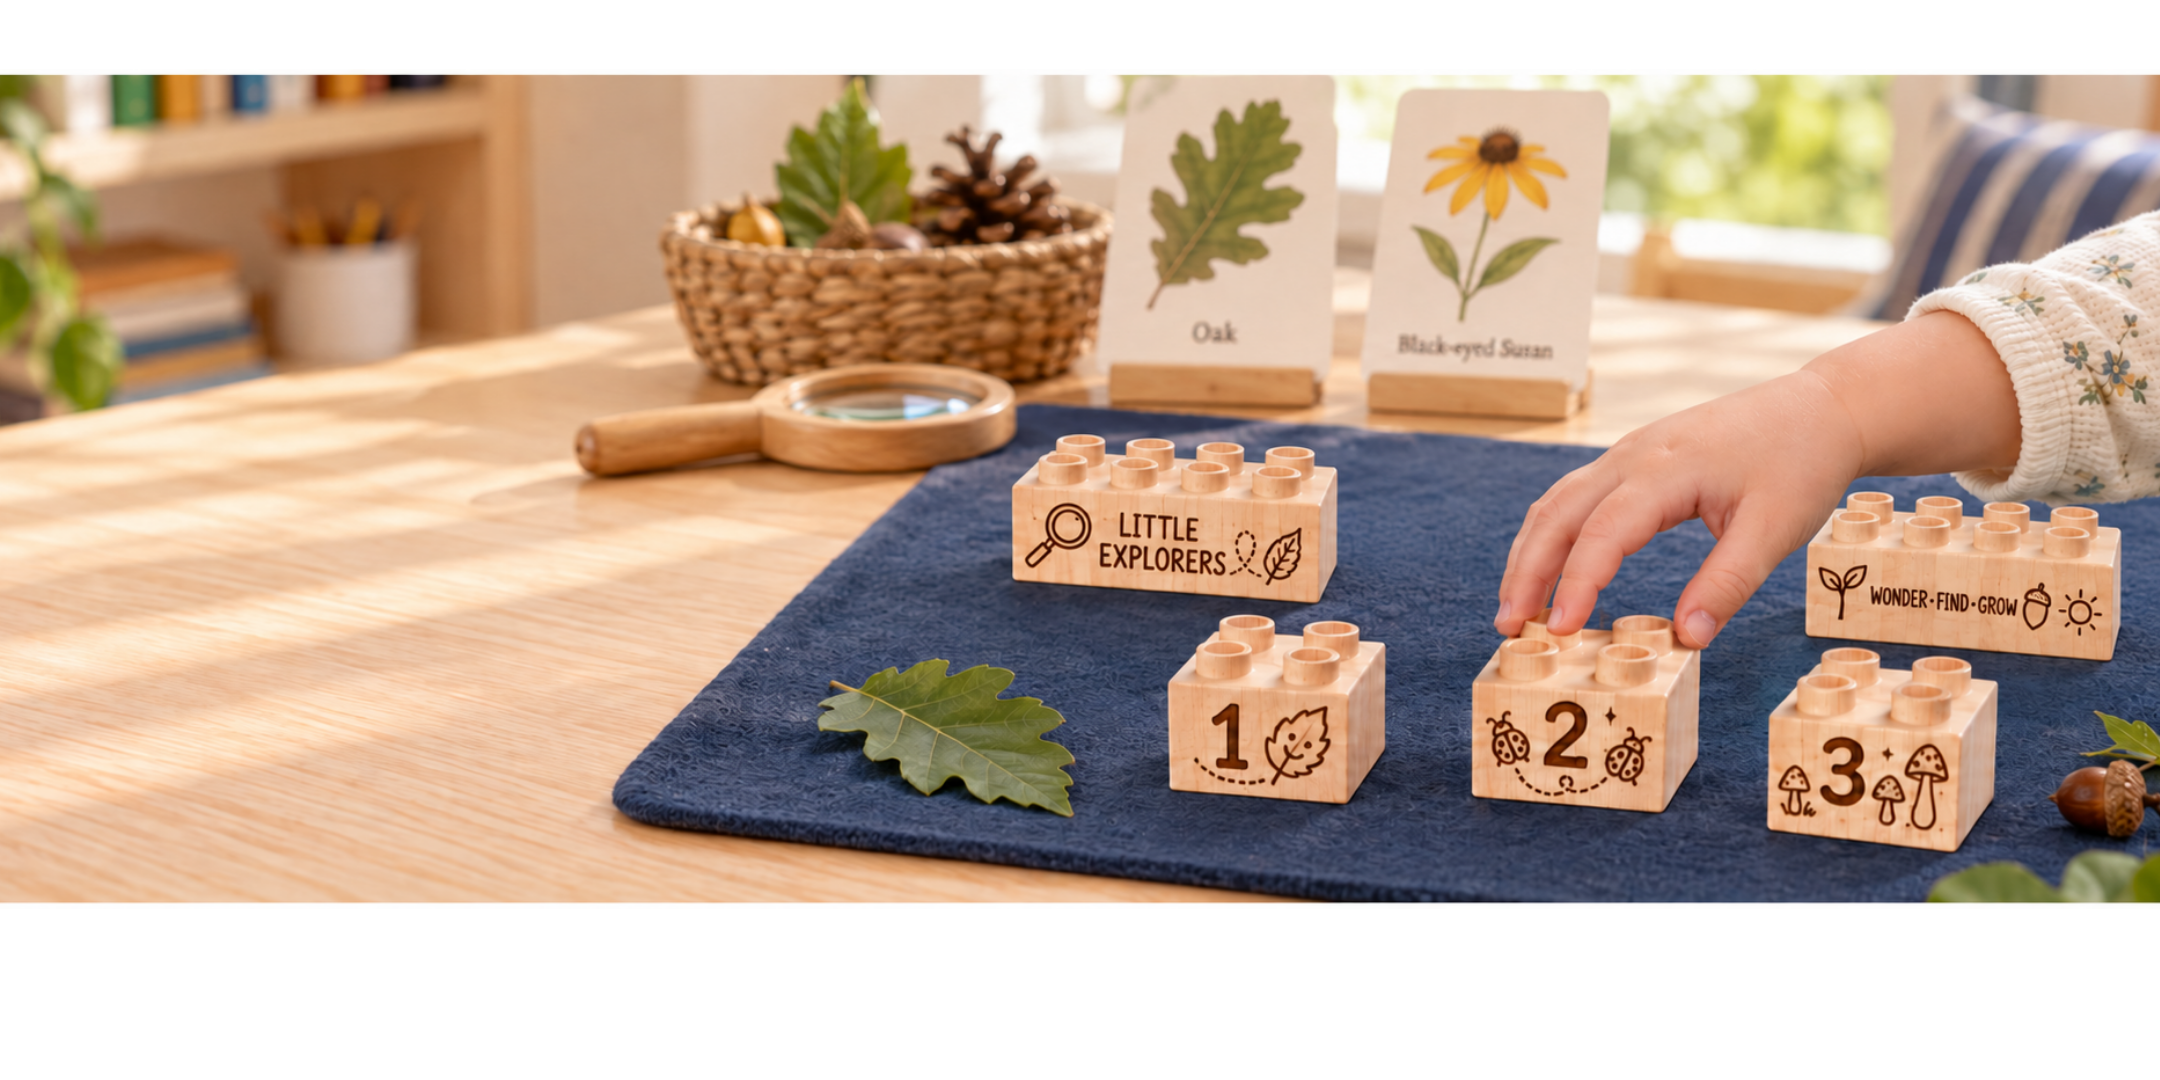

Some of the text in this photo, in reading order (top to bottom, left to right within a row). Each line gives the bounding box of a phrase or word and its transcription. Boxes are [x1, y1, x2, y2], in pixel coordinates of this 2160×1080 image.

[1191, 320, 1238, 345] Oak
[1397, 333, 1554, 364] Black-eyed Susan
[1119, 511, 1199, 543] LITTLE
[1099, 542, 1226, 576] EXPLORERS
[1211, 702, 1249, 771] 1
[1542, 700, 1590, 770] 2
[1819, 736, 1867, 807] 3
